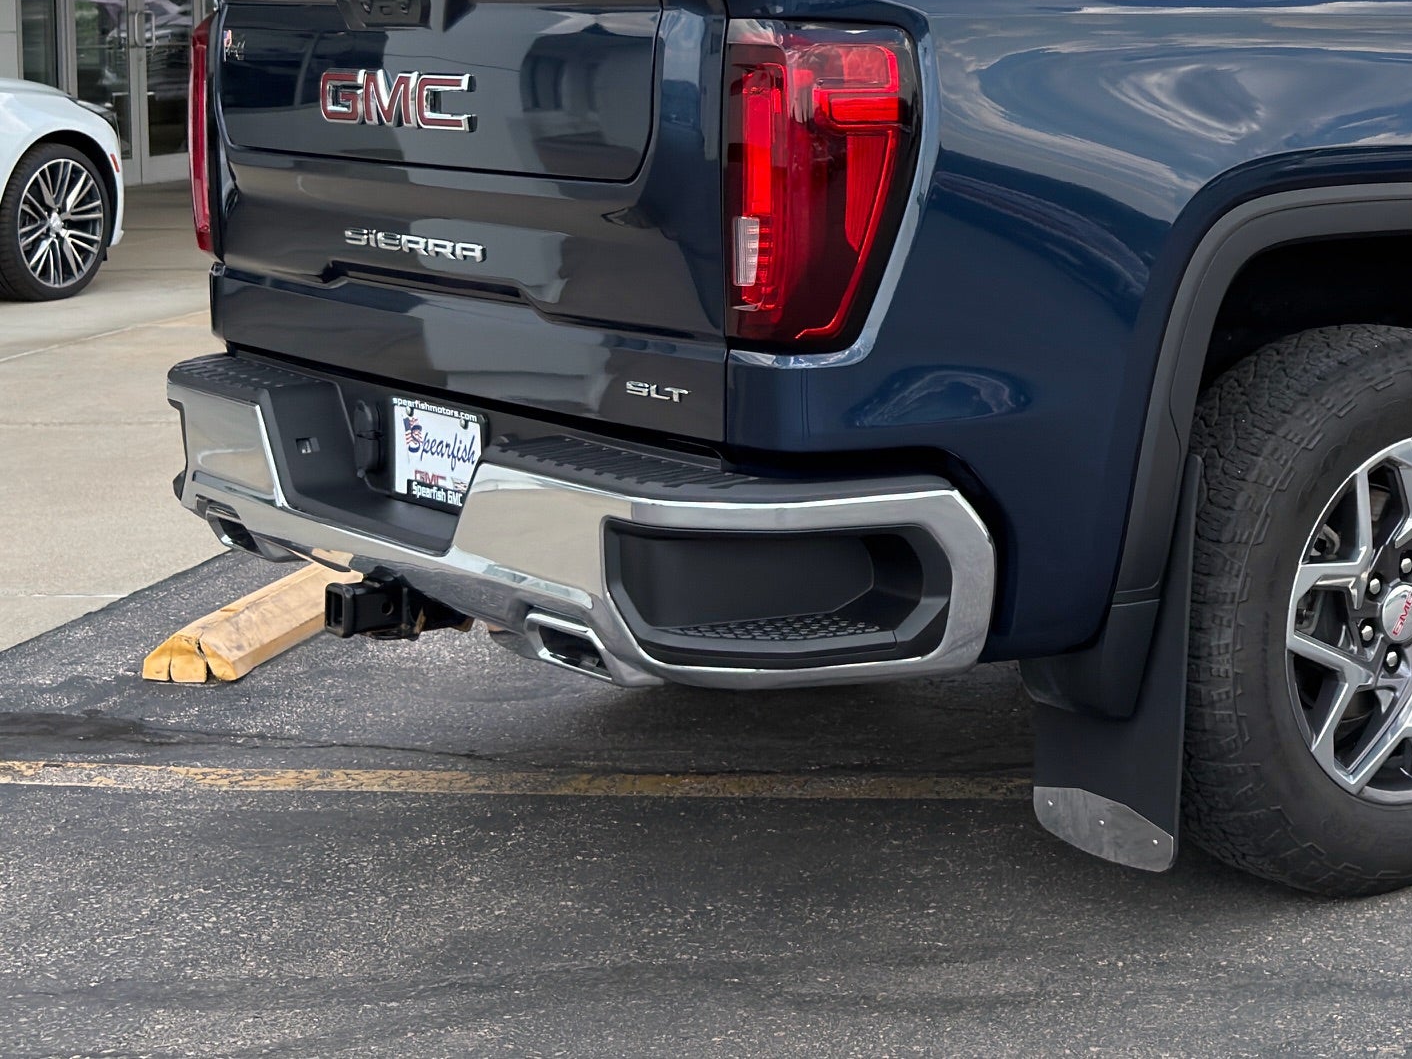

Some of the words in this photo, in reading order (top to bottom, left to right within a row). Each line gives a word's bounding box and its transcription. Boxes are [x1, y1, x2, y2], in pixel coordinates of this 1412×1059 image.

[320, 68, 477, 133] GMC
[344, 228, 487, 263] SIERRA
[625, 380, 690, 403] SLT
[392, 397, 477, 422] spearfishmotors.com
[408, 424, 476, 472] Spearfish
[412, 482, 446, 502] Spearfish
[447, 492, 464, 507] GMC
